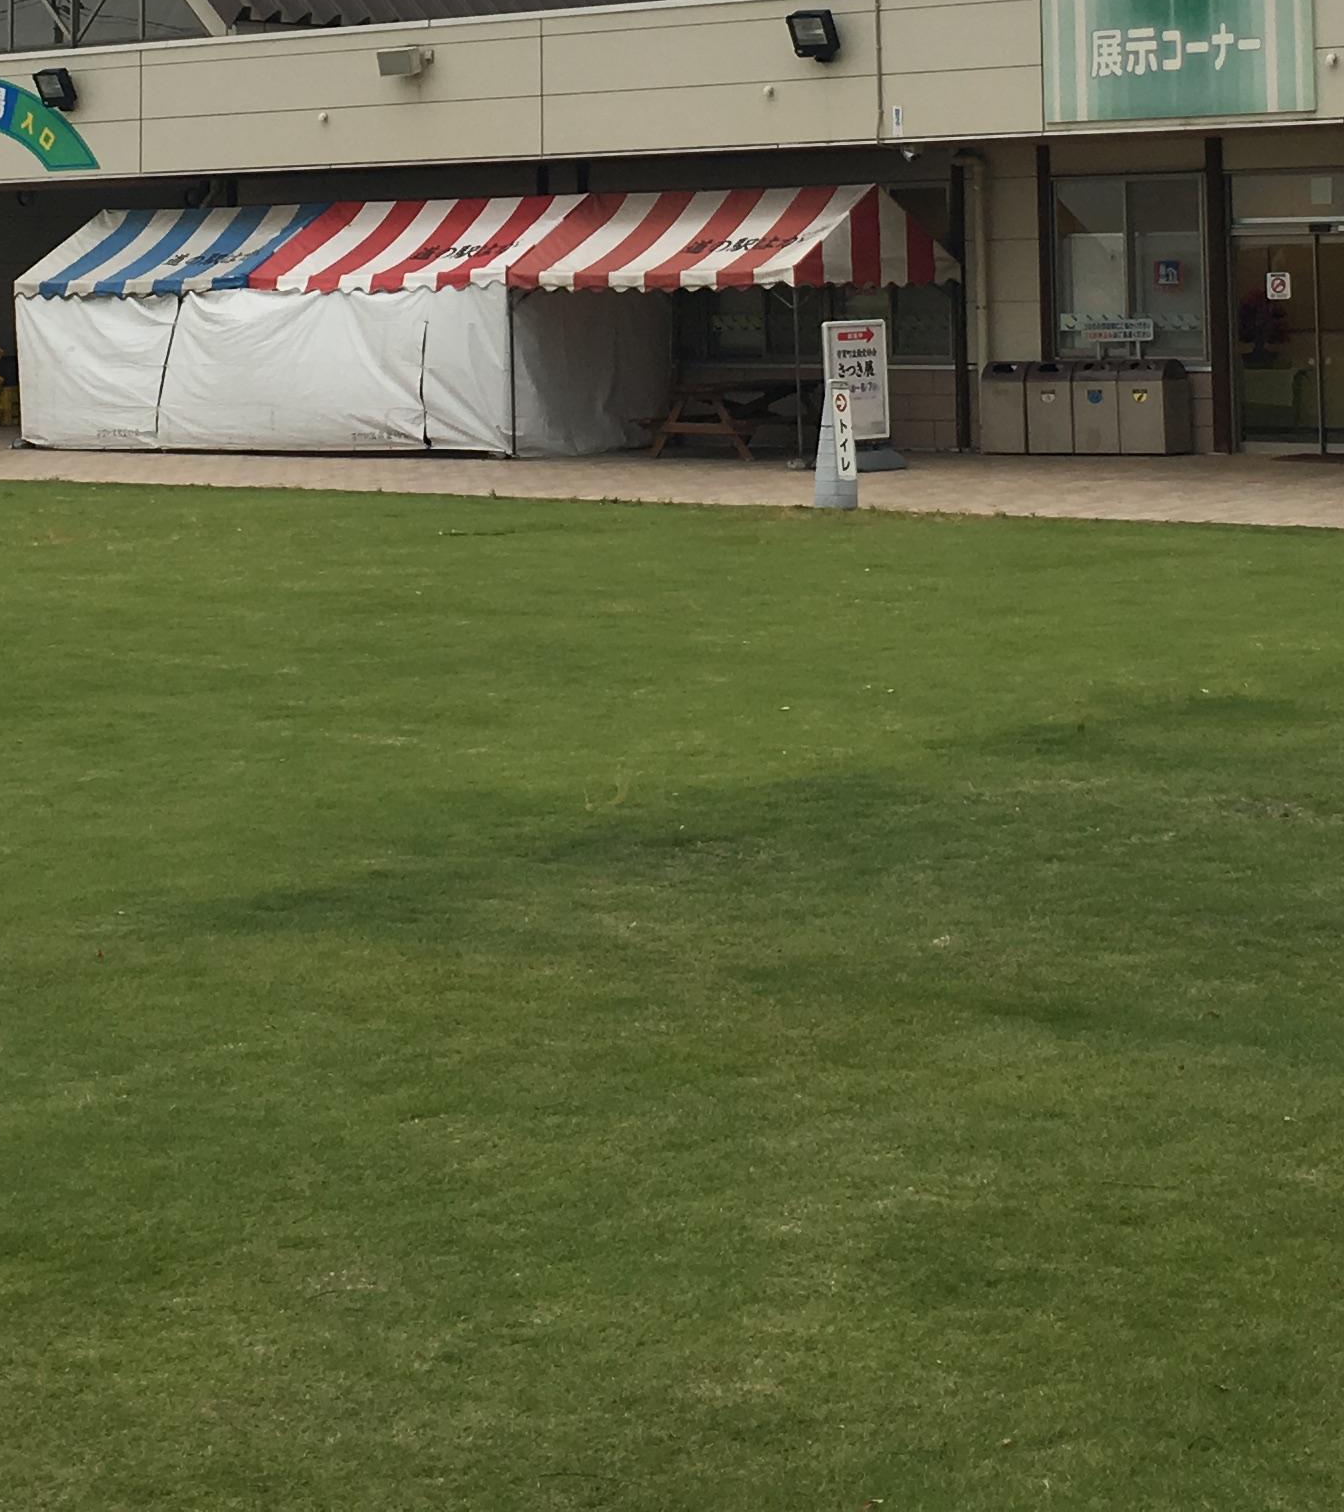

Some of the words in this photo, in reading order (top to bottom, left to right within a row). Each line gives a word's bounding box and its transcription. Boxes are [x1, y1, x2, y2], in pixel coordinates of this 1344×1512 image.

[1092, 23, 1261, 77] 展示コーナー
[21, 112, 55, 151] 入口
[838, 360, 875, 378] さつき展
[840, 418, 851, 472] トイレ
